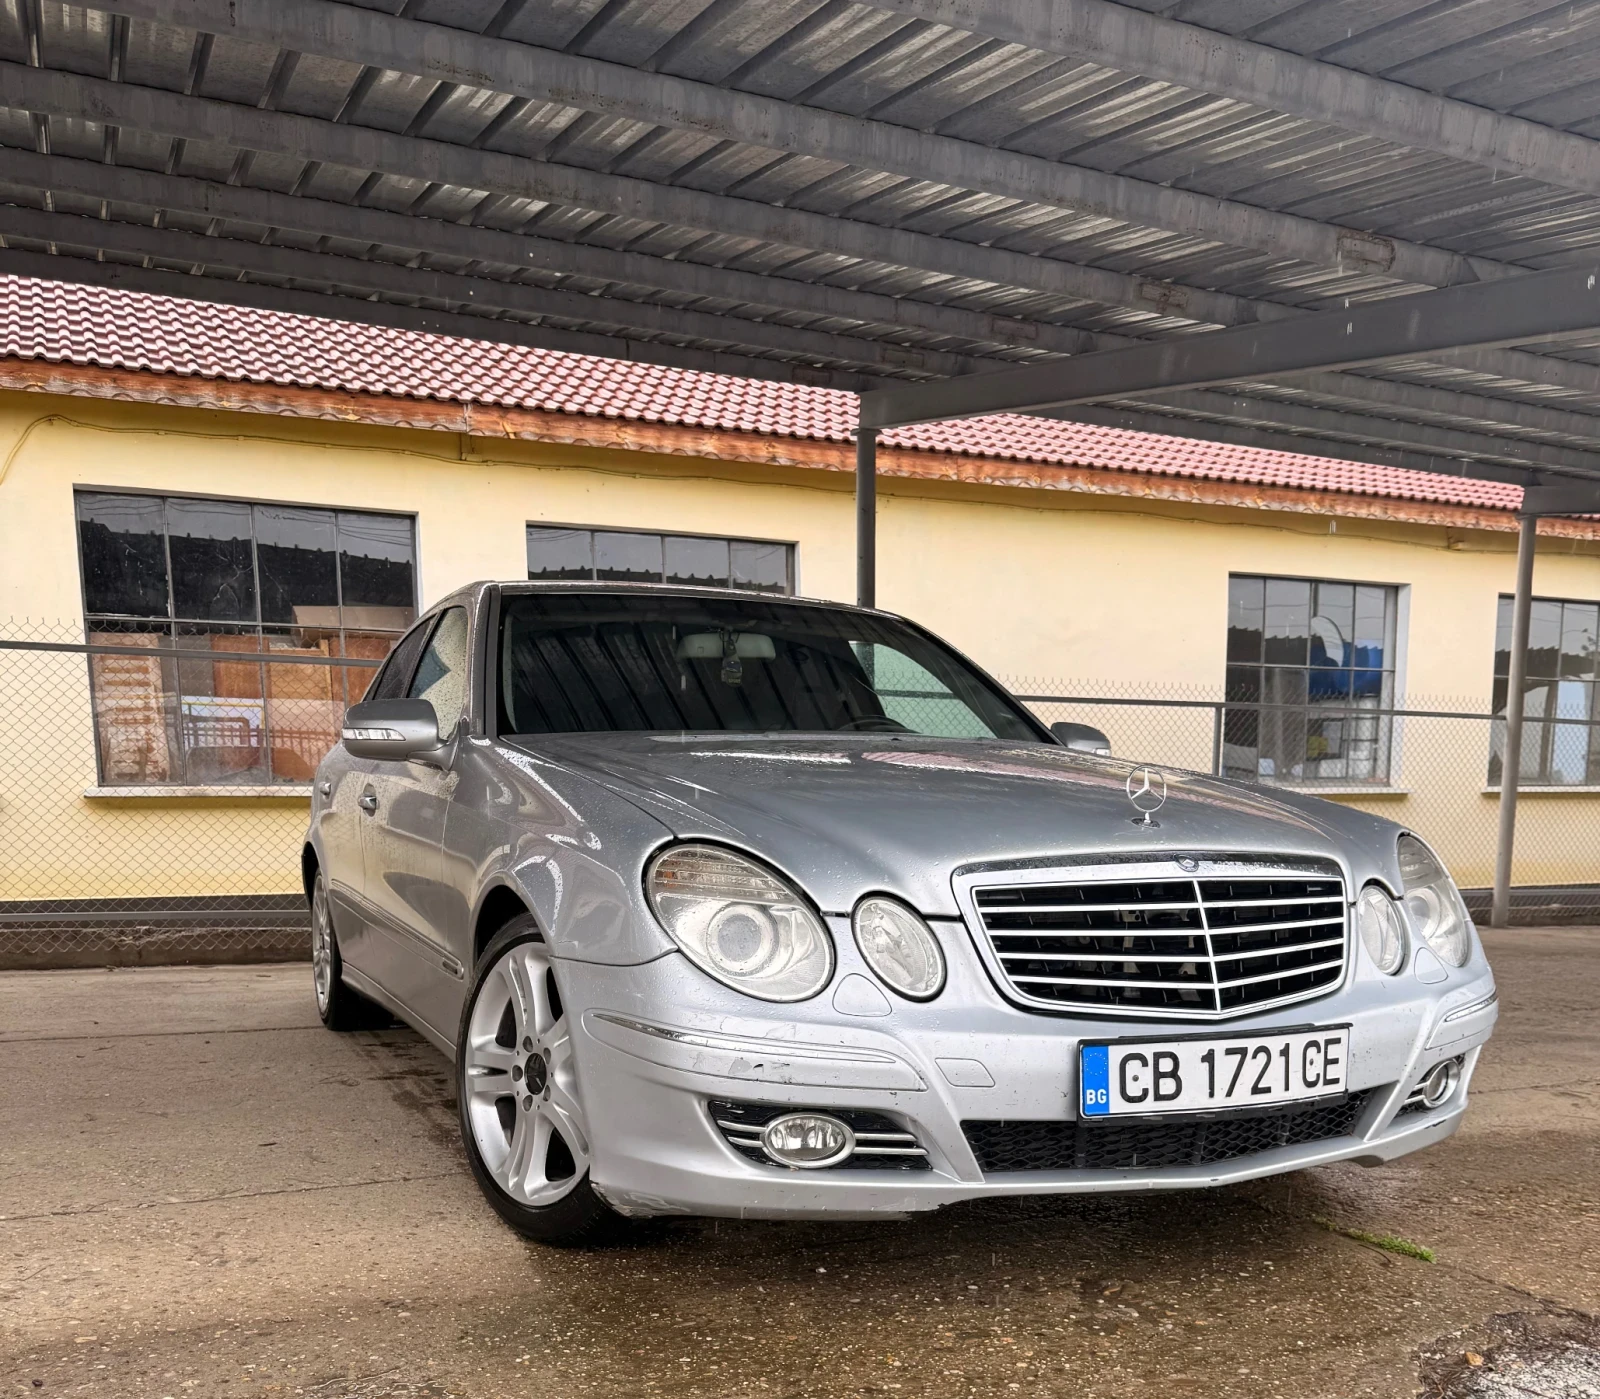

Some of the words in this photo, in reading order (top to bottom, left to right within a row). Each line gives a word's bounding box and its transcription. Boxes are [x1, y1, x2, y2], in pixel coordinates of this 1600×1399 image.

[1119, 1051, 1182, 1103] CB
[1201, 1042, 1290, 1098] 1721
[1302, 1037, 1341, 1088] CE
[1086, 1088, 1107, 1105] BG
